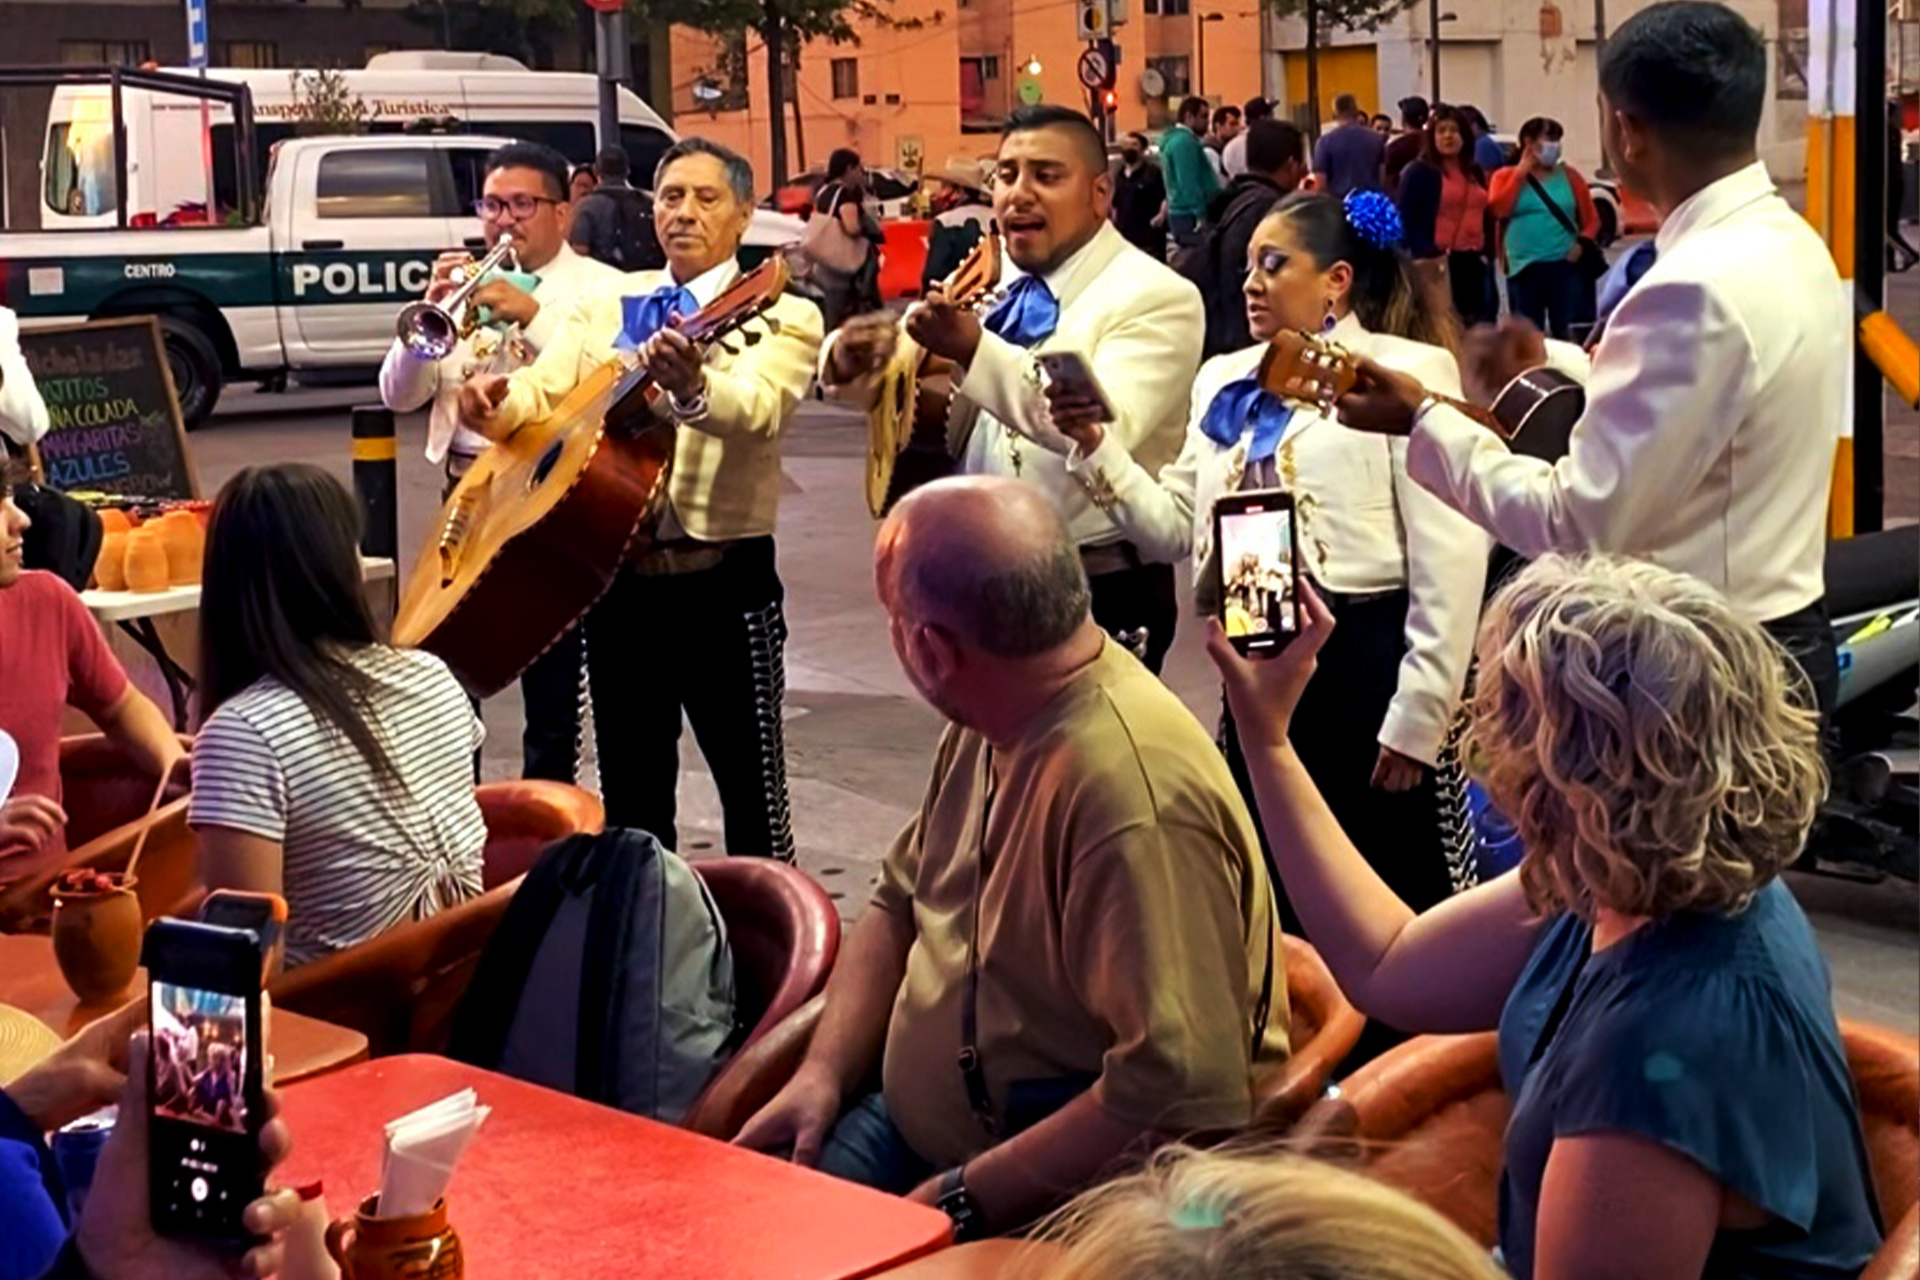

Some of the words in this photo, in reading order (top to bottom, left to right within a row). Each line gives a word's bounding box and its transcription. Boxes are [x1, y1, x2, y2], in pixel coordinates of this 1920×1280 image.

[124, 264, 176, 279] CENTRO
[293, 262, 429, 296] POLIC
[39, 376, 109, 403] OJITOS
[74, 398, 138, 427] COLADA
[50, 453, 130, 485] AZULES
